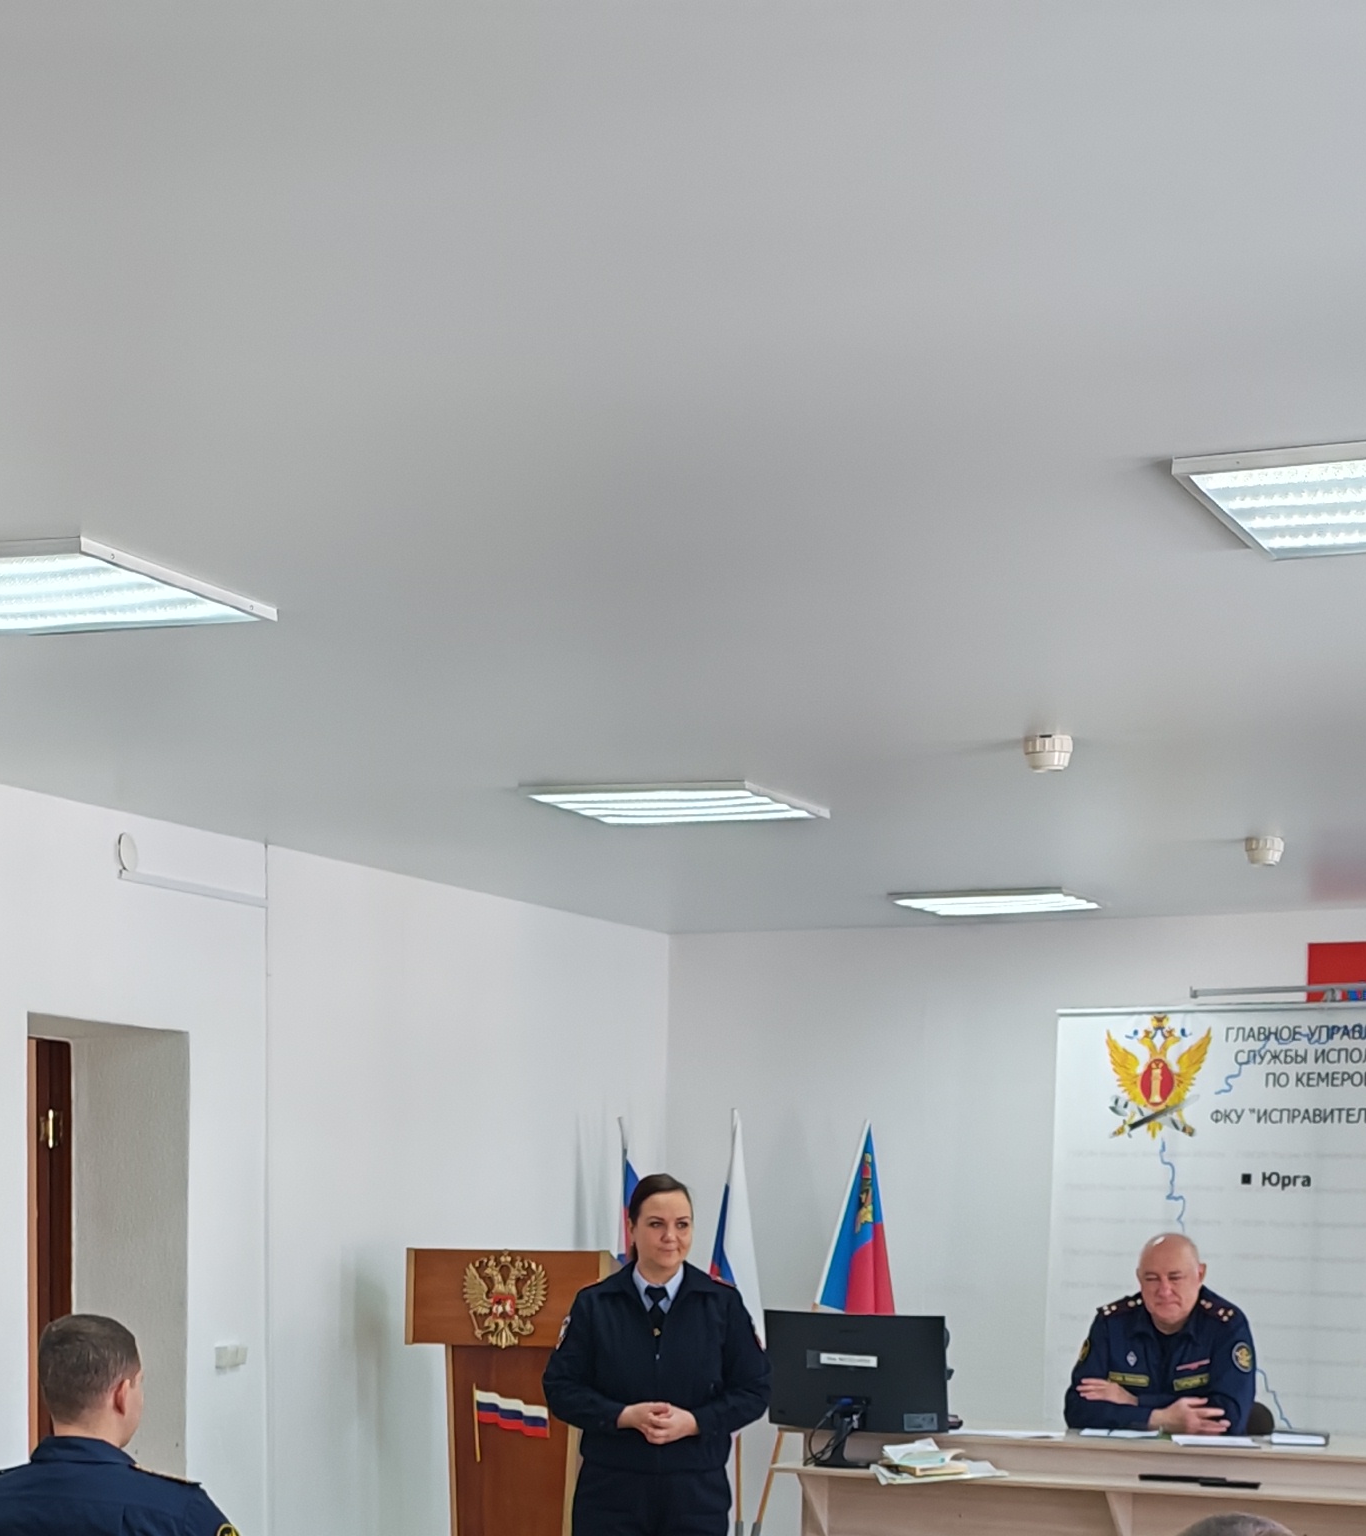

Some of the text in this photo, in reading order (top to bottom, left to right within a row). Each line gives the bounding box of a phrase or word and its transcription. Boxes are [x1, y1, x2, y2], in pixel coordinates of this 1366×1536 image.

[1225, 1025, 1303, 1043] ГЛАВНОЕ
[1234, 1048, 1308, 1065] СЛУЖБЫ
[1265, 1072, 1290, 1088] ПО
[1210, 1108, 1246, 1124] ФКУ
[1261, 1171, 1312, 1191] Юрга
